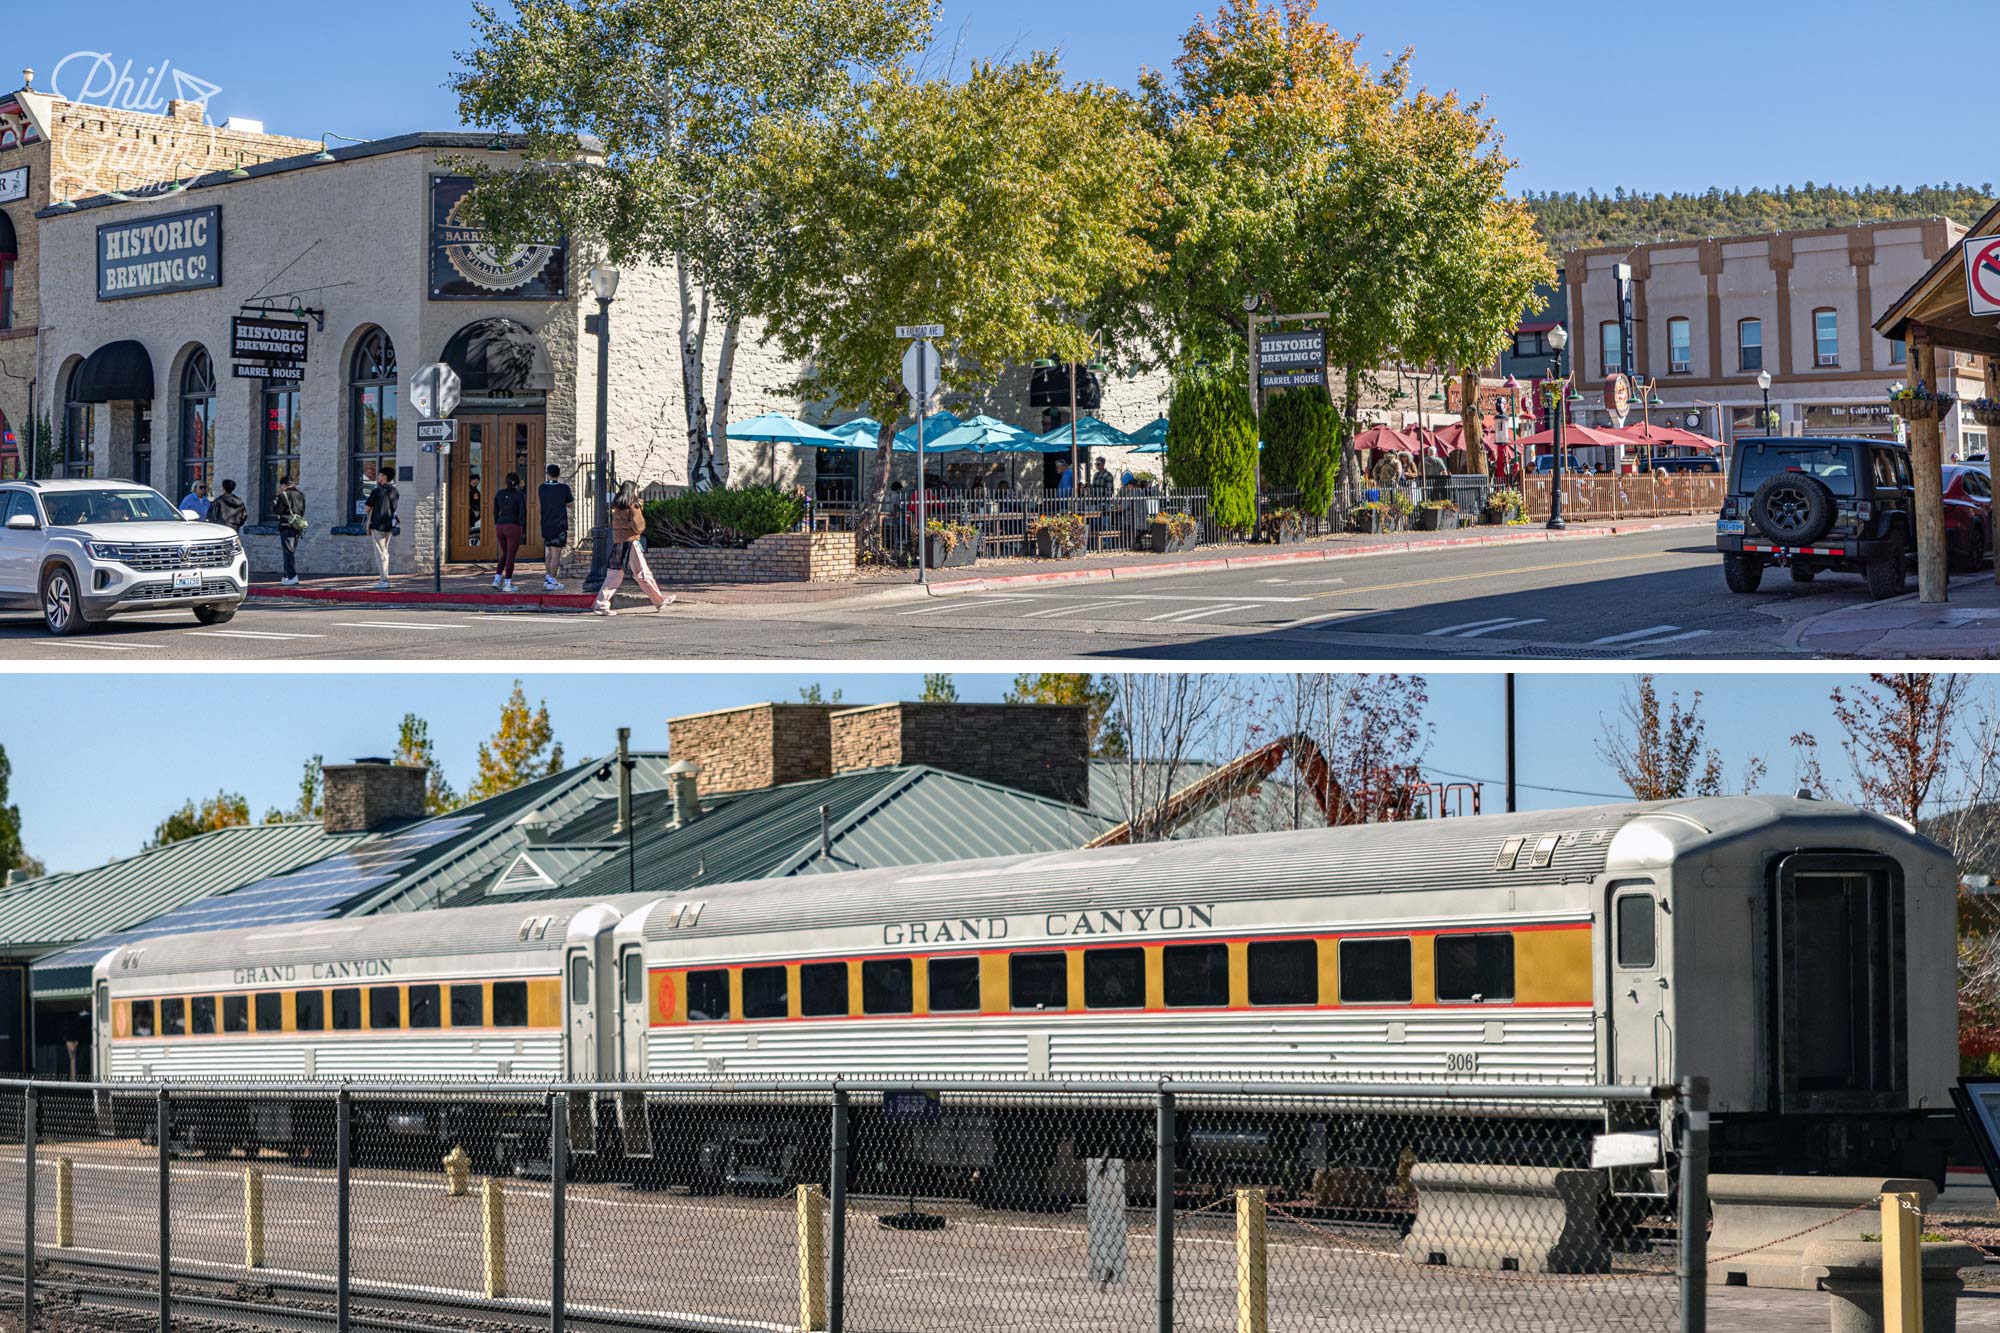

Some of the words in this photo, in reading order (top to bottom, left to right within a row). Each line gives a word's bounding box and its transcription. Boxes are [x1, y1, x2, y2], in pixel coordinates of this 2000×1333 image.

[106, 217, 207, 260] HISTORIC
[522, 251, 533, 266] AZ
[106, 258, 183, 290] BREWING
[236, 325, 305, 342] HISTORIC
[929, 325, 938, 335] AVE
[236, 340, 290, 353] BREWING
[1261, 338, 1321, 353] HISTORIC
[1261, 352, 1309, 363] BREWING
[238, 366, 270, 377] BARREL
[272, 369, 301, 379] HOUSE
[1264, 376, 1291, 386] BARREL
[1293, 374, 1319, 384] HOUSE
[1831, 407, 1847, 416] The
[1849, 406, 1880, 416] Gallery
[420, 427, 431, 436] ONE
[432, 426, 443, 436] WAY
[883, 917, 1008, 946] GRAND
[1046, 904, 1216, 936] CANYON
[233, 965, 296, 985] GRAND
[312, 959, 392, 979] CANYON
[1448, 1053, 1473, 1071] 306
